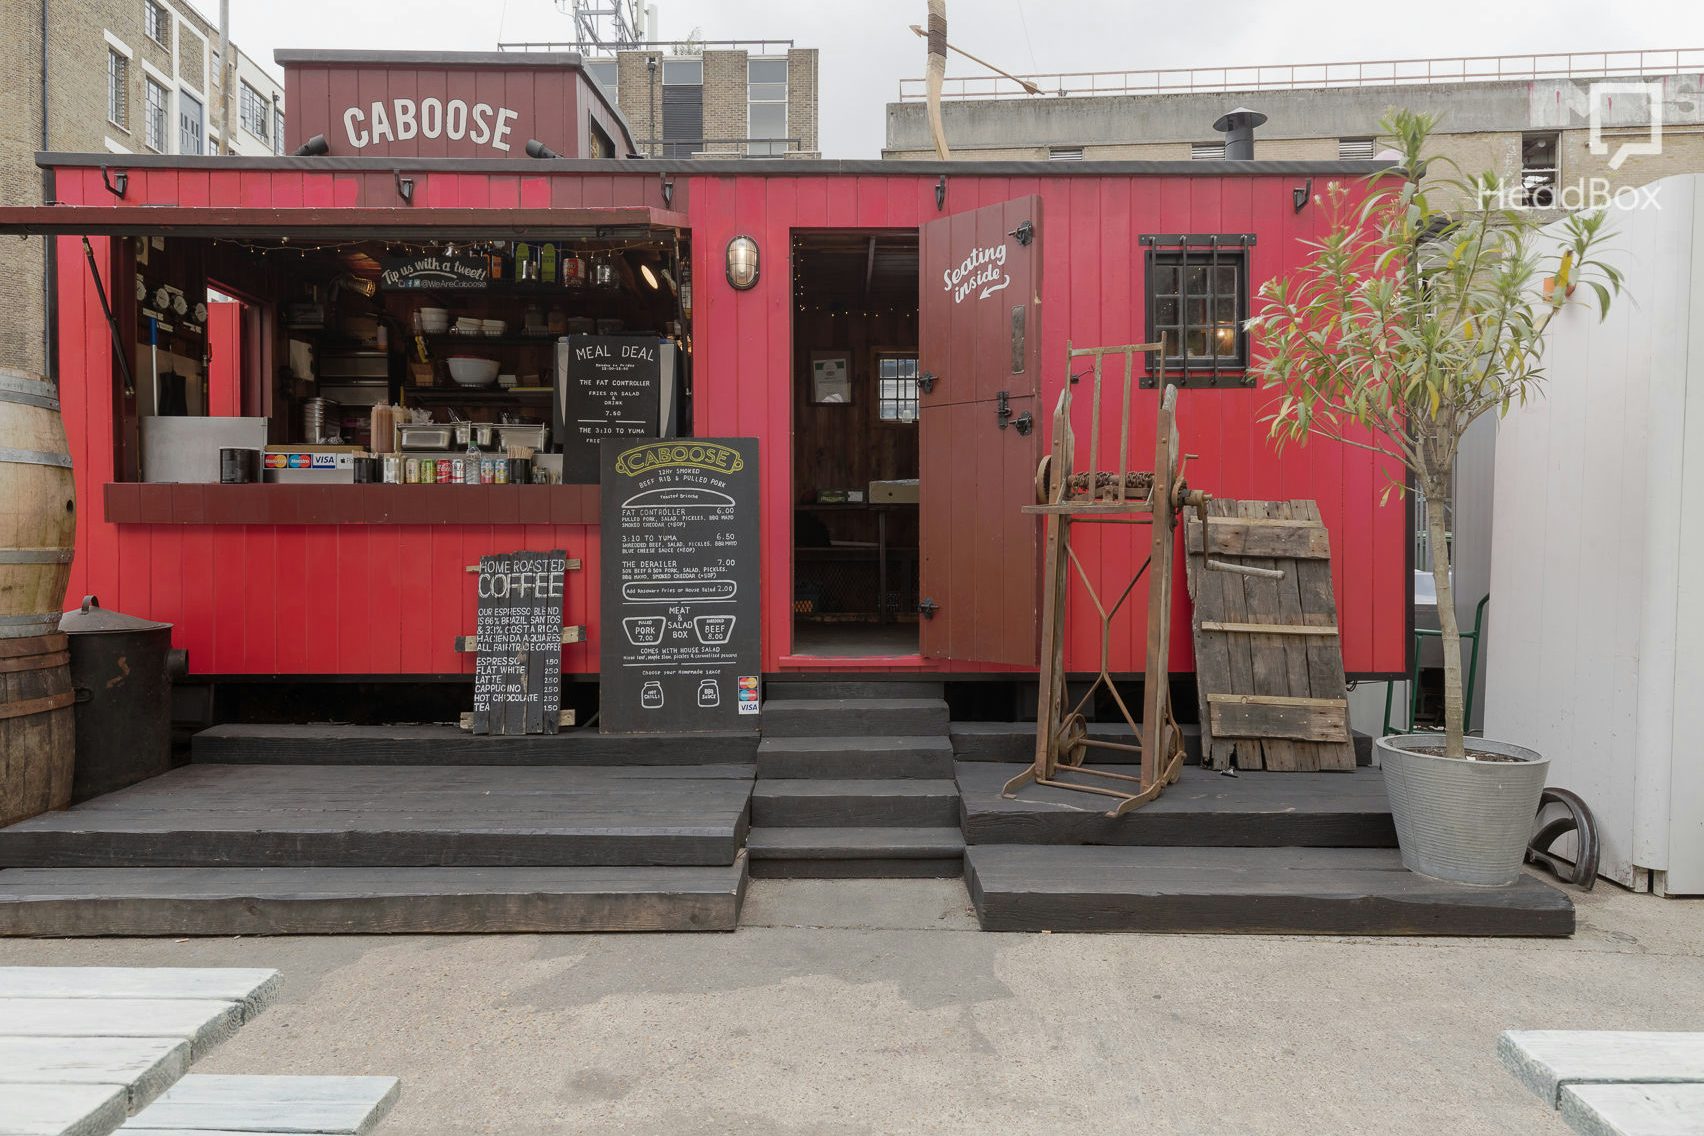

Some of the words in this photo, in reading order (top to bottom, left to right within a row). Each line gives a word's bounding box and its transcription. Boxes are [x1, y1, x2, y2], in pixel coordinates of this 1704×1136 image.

[343, 97, 519, 151] CABOOSE
[381, 269, 399, 285] Tip
[400, 264, 413, 276] us
[415, 258, 440, 270] with
[442, 262, 450, 271] a
[454, 261, 486, 280] tweet!
[944, 244, 1006, 291] Seating
[955, 264, 999, 303] inside
[576, 345, 611, 360] MEAL
[621, 346, 653, 361] DEAL
[628, 447, 730, 469] CABOOSE
[639, 478, 654, 488] BEEF
[683, 475, 707, 483] PULLED
[711, 478, 726, 488] PORK
[479, 561, 510, 573] HOME
[514, 559, 565, 572] ROASTED
[478, 572, 564, 599] COFFEE
[478, 608, 493, 616] OUR
[495, 607, 531, 615] ESPRESSO
[533, 606, 559, 615] BLEND
[478, 617, 484, 625] IS
[501, 616, 527, 624] BRAZIL
[505, 625, 535, 634] COSTA
[537, 625, 559, 633] RICA
[705, 625, 725, 633] BEEF
[477, 635, 521, 643] HACIENDA
[476, 643, 491, 651] ALL
[535, 643, 561, 651] COFFEE
[476, 666, 497, 674] FLAT
[500, 666, 525, 674] WHITE
[476, 675, 501, 684] LATTE
[475, 685, 521, 693] CAPPUCINO
[474, 694, 489, 702] HOT
[493, 694, 538, 702] CHOCOLATE
[474, 703, 490, 711] TEA
